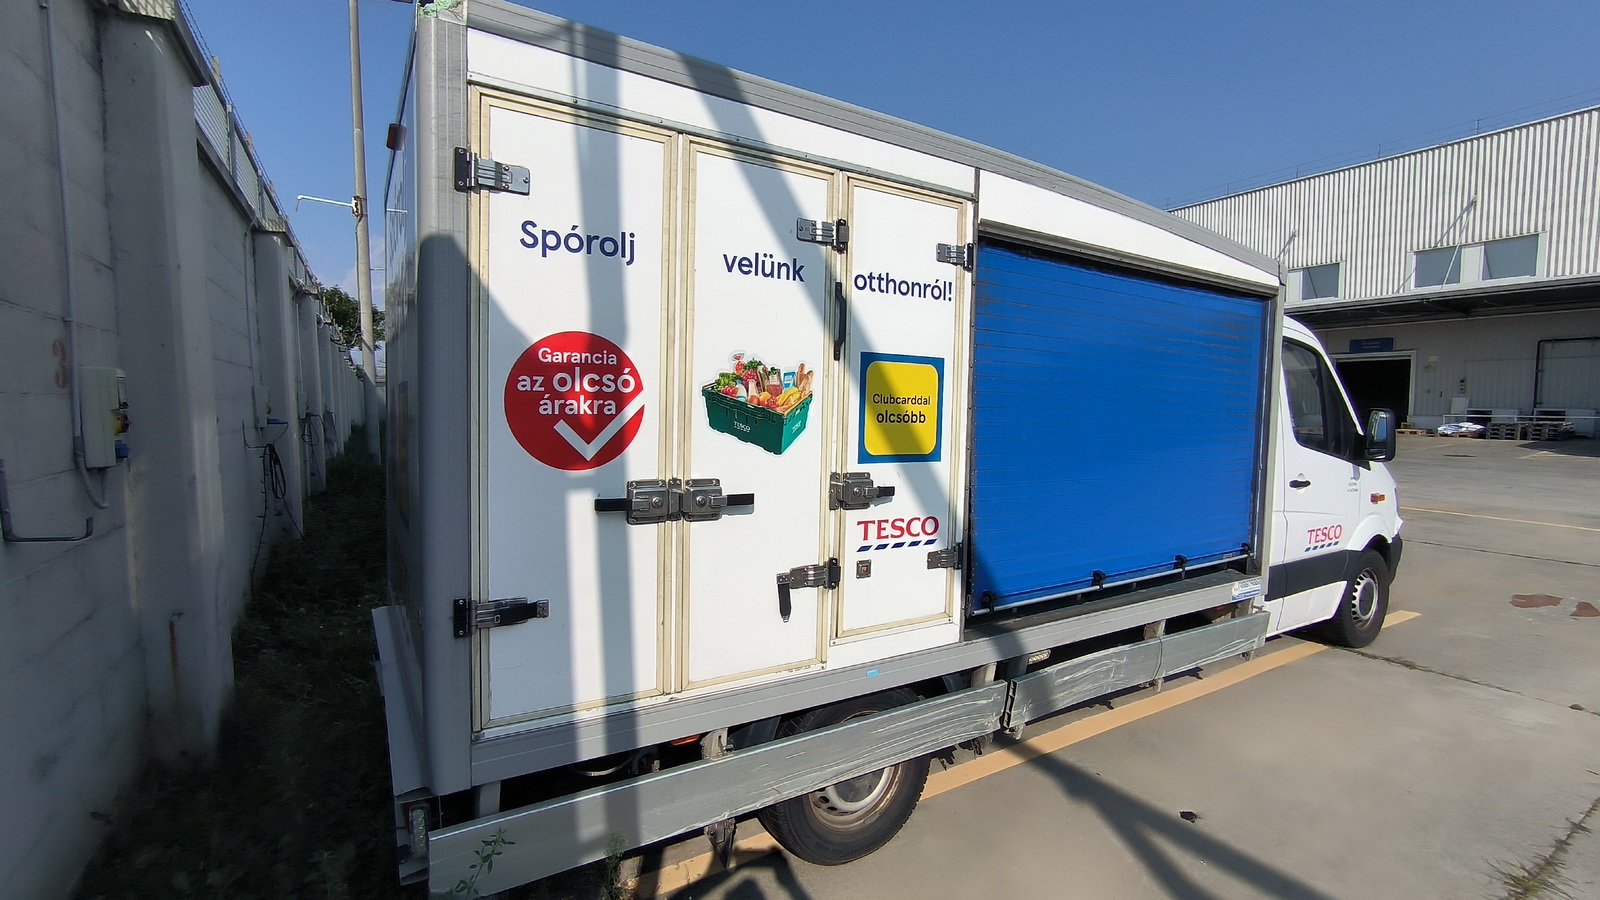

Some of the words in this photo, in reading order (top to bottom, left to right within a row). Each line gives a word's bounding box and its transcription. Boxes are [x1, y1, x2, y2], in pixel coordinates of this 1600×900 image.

[520, 220, 636, 266] Spórolj
[723, 252, 805, 283] velünk
[854, 270, 953, 302] otthonról!
[537, 347, 618, 366] Garancia
[517, 376, 544, 393] az
[553, 366, 636, 393] olcsó
[539, 395, 617, 416] árakra
[872, 393, 931, 406] Clubcarddal
[876, 409, 927, 425] olcsóbb
[857, 516, 939, 541] TESCO
[1307, 524, 1343, 545] TESCO
